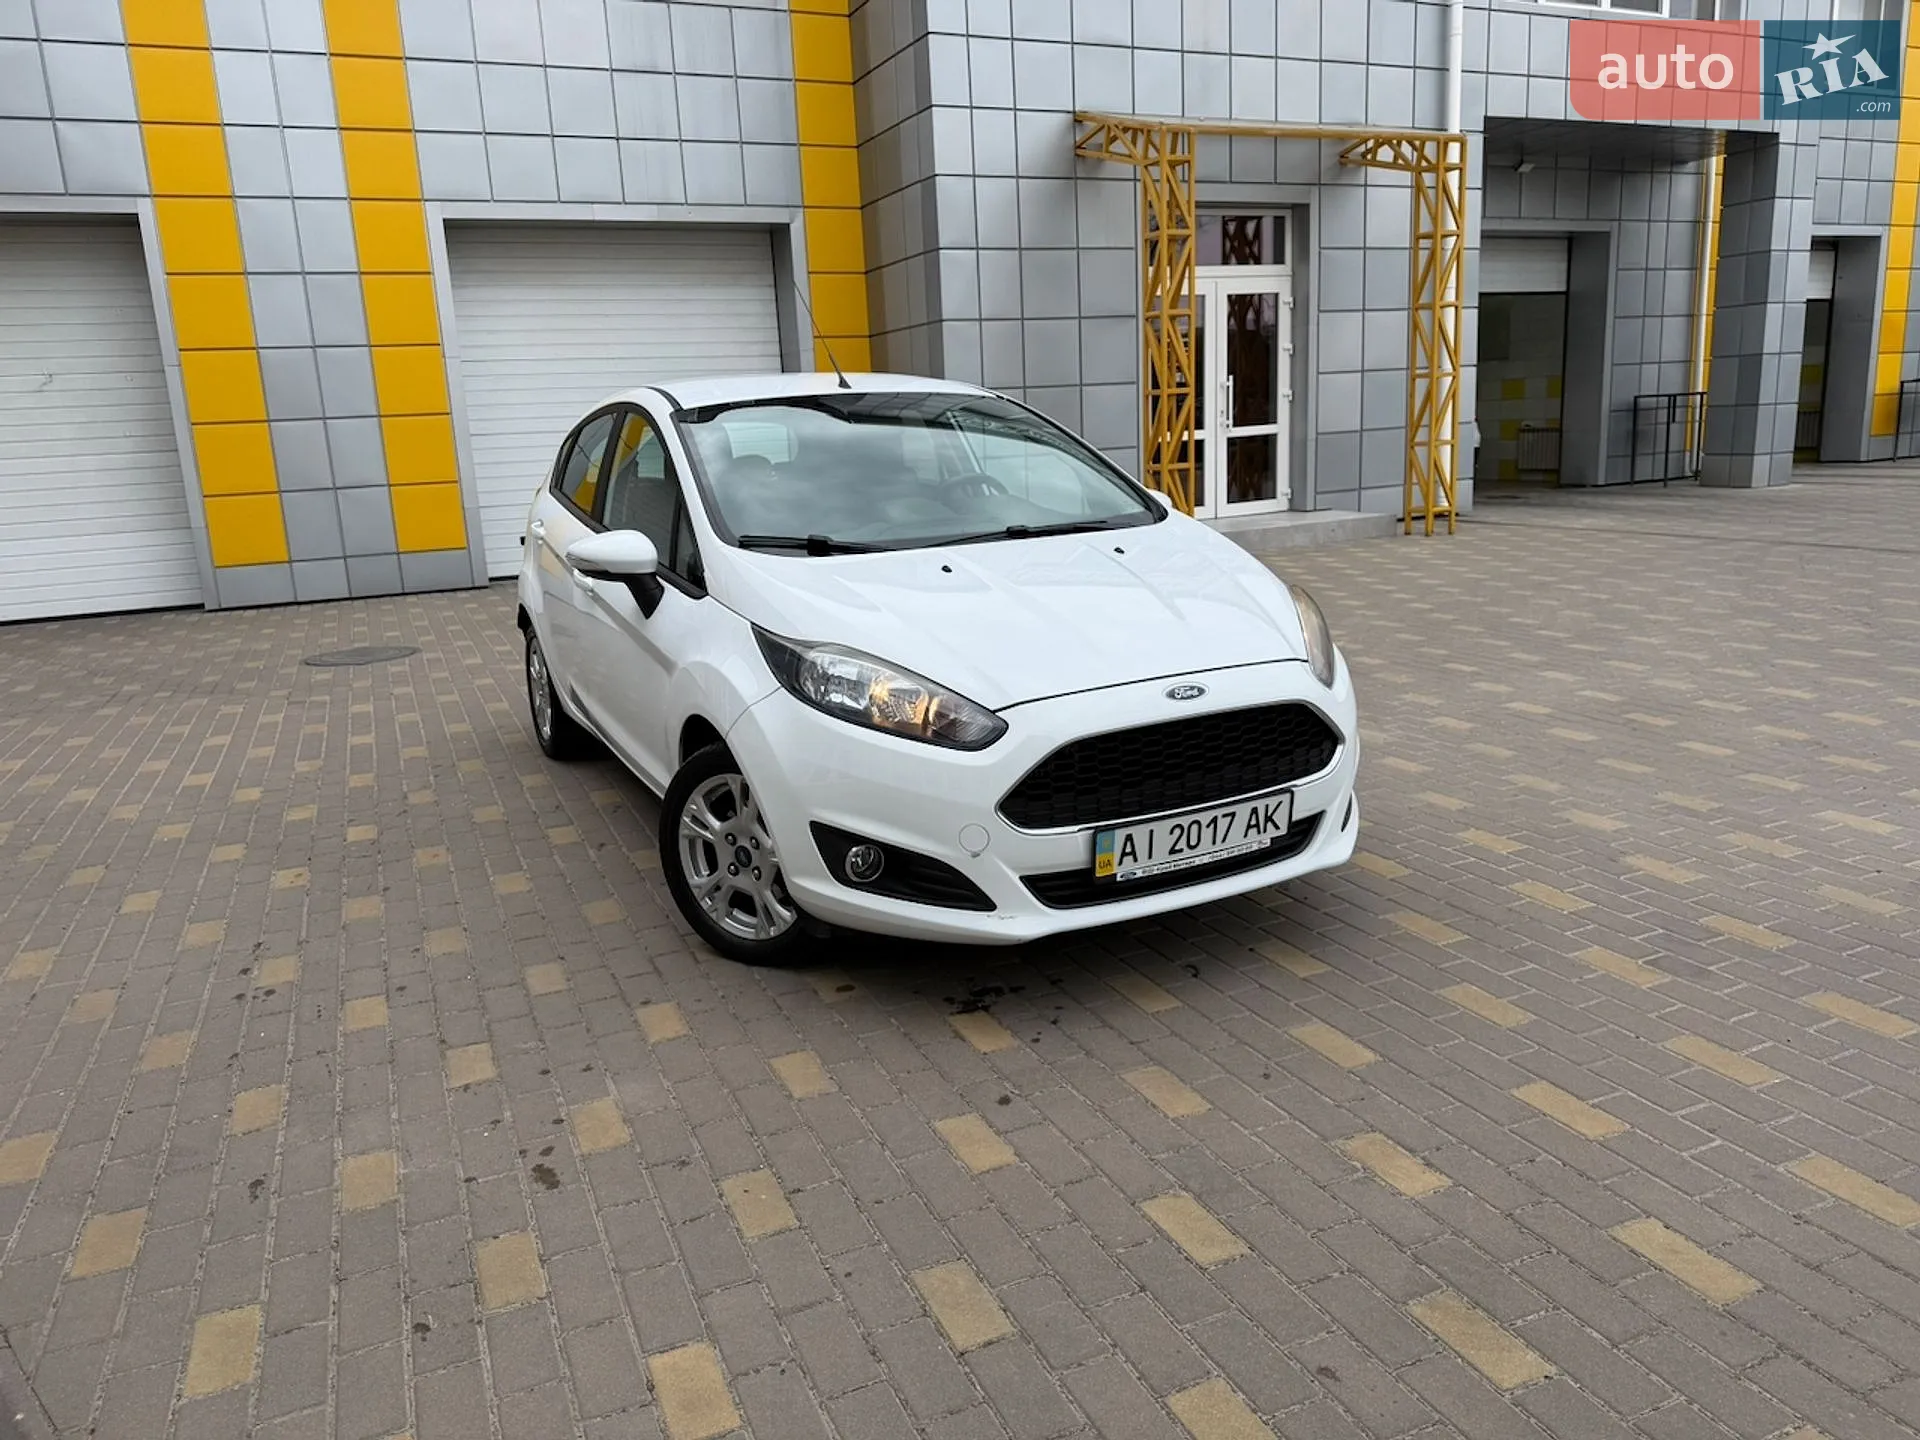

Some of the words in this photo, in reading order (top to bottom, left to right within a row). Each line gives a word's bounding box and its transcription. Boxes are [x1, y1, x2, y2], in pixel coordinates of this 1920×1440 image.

[1174, 686, 1200, 699] Ford
[1118, 829, 1154, 867] AI
[1168, 812, 1237, 855] 2017
[1243, 800, 1284, 839] AK
[1098, 858, 1112, 870] UA
